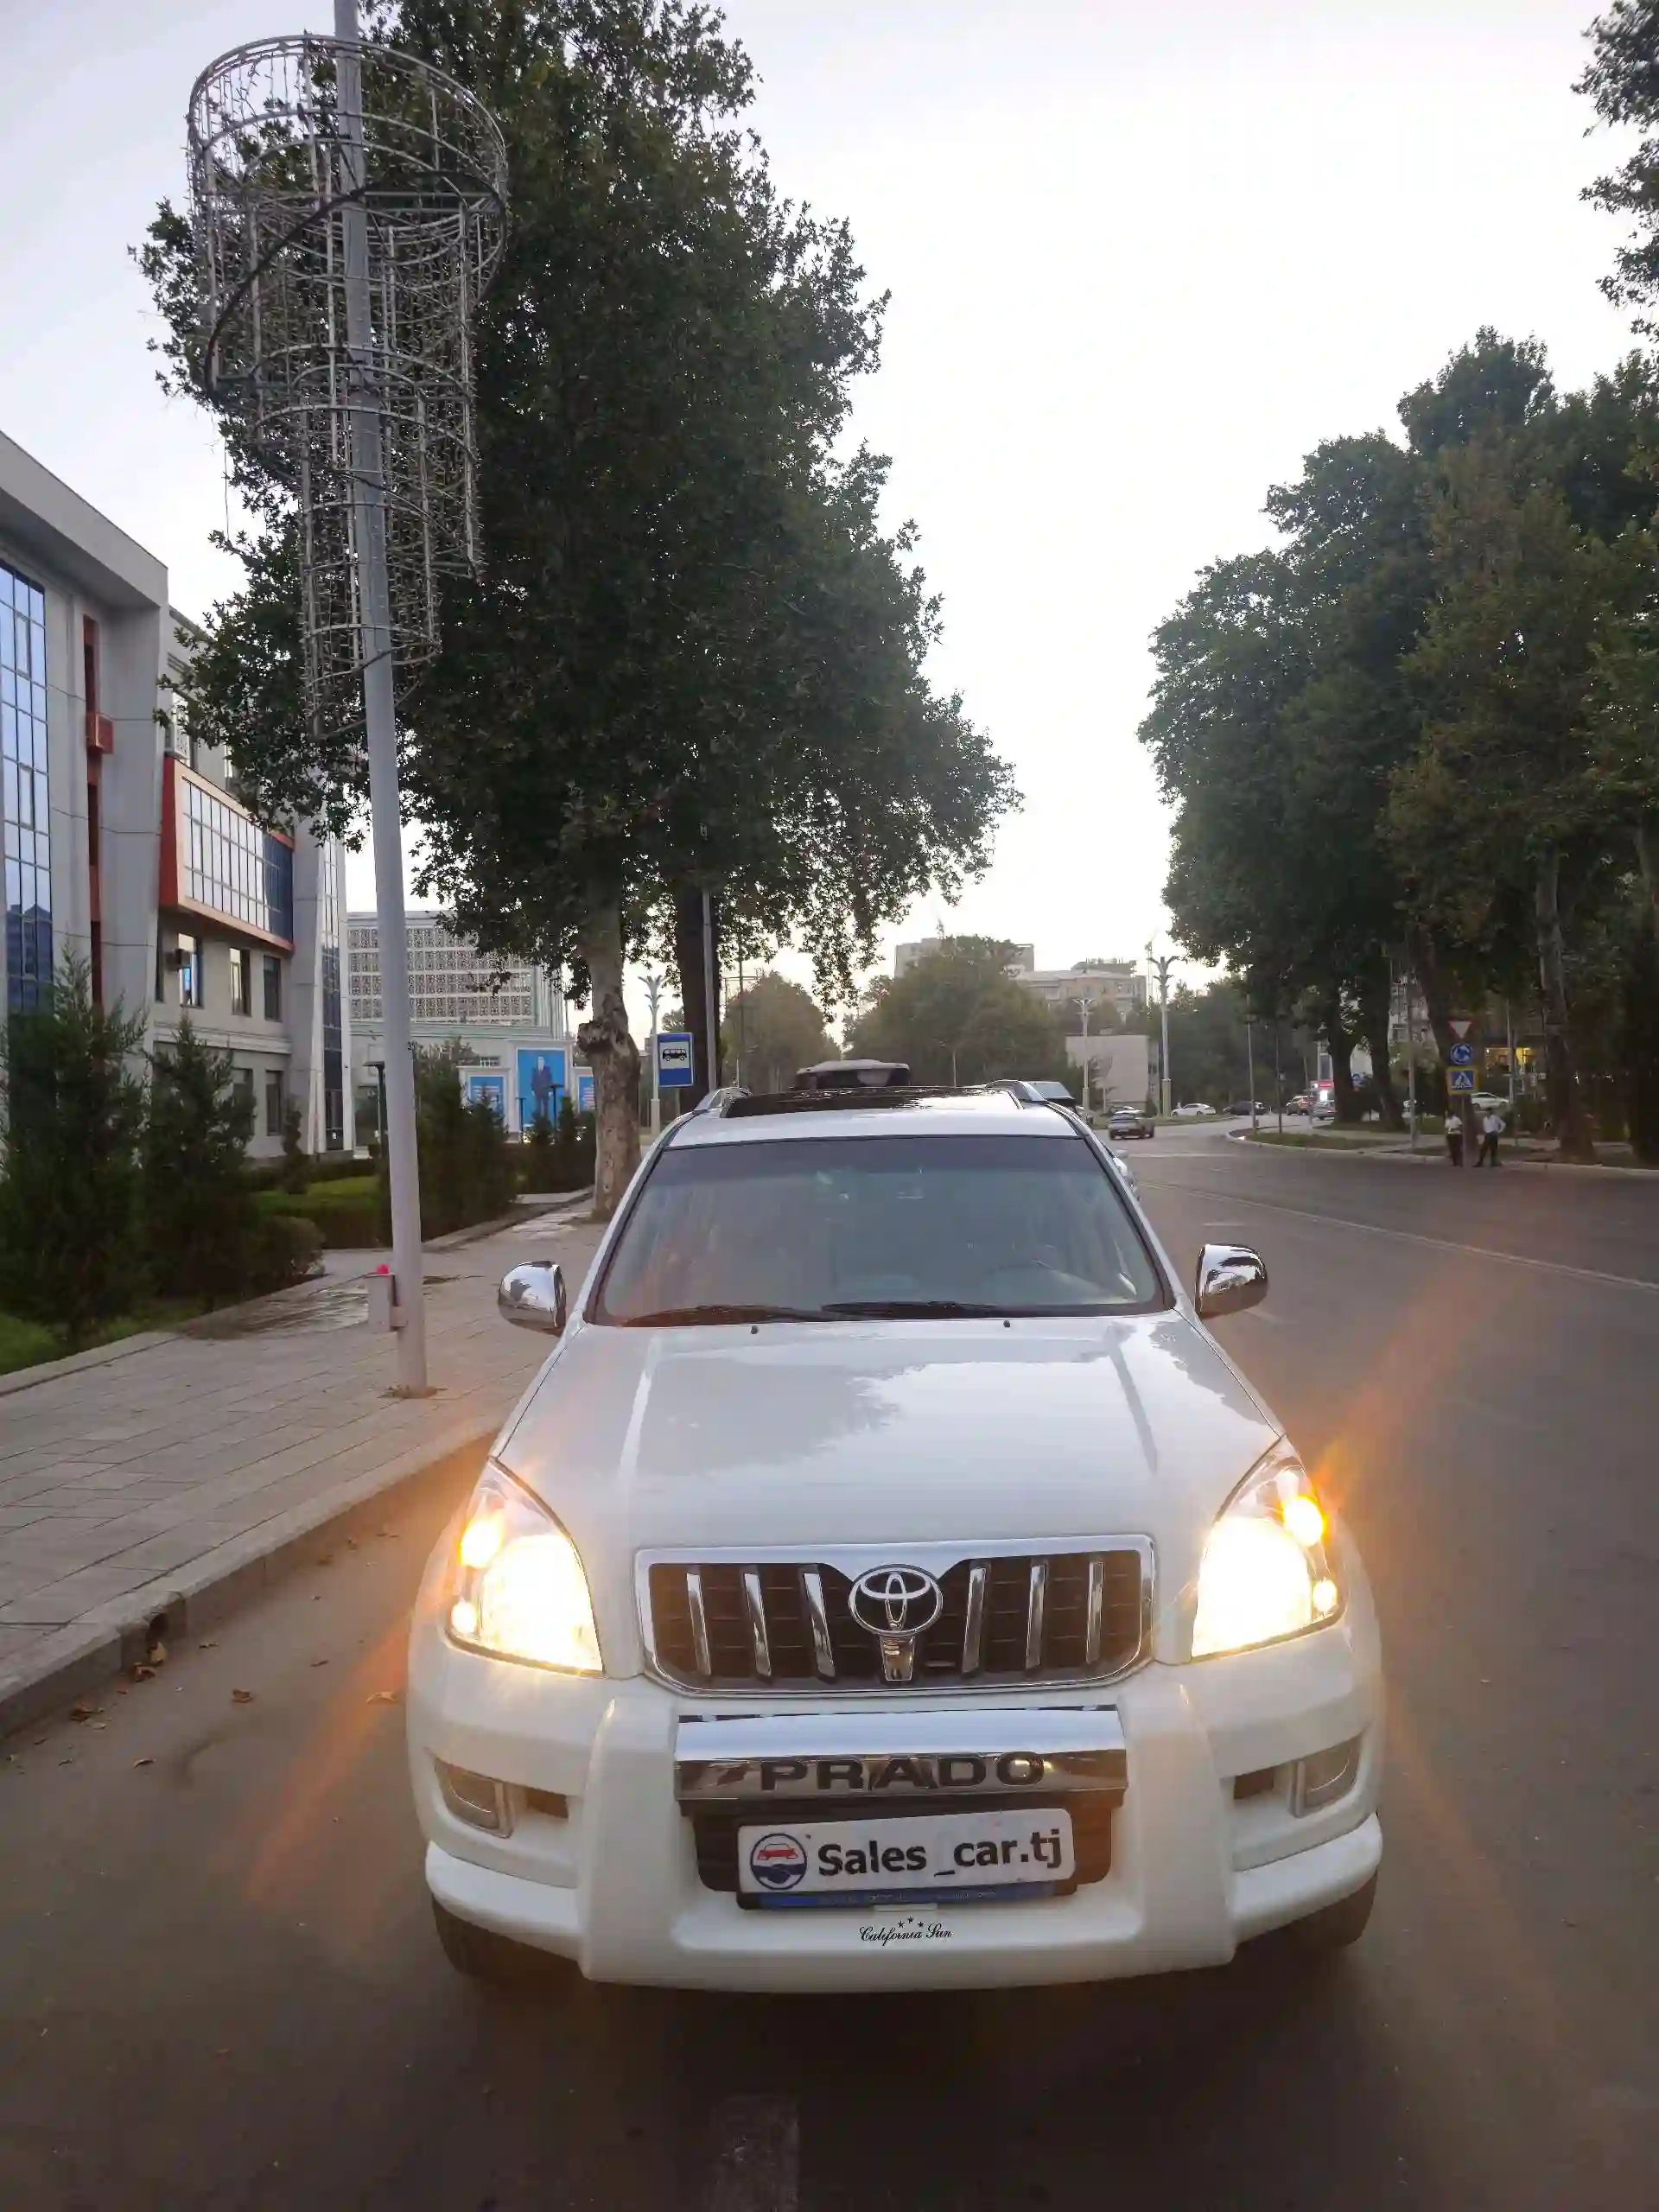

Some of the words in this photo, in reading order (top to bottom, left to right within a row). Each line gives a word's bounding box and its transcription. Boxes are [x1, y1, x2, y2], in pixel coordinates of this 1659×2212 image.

[761, 1752, 1045, 1791] PRADO
[860, 1926, 922, 1946] California
[926, 1922, 953, 1938] Sun
